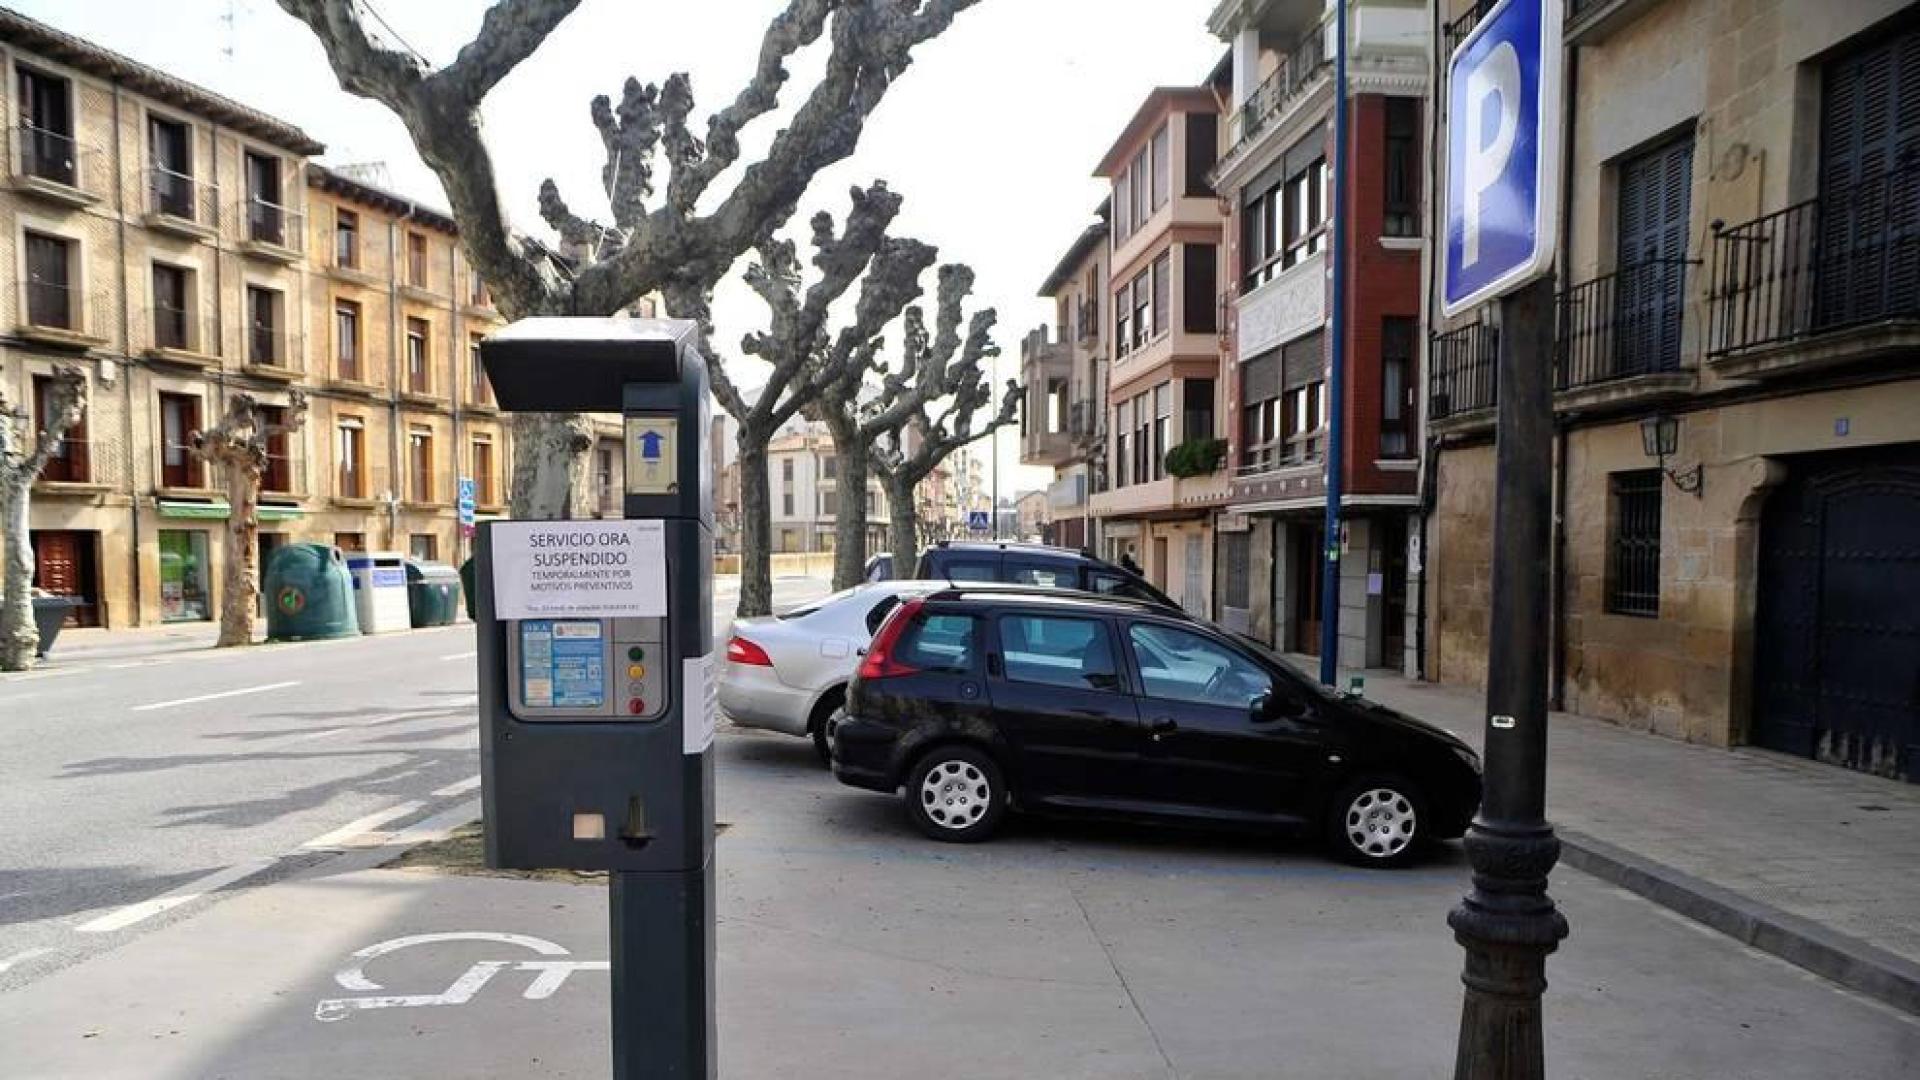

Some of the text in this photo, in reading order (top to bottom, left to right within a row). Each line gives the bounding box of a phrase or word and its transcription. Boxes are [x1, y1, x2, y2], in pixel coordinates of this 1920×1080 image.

[1462, 40, 1522, 270] P
[529, 533, 631, 547] SERVICIO ORA
[533, 552, 628, 567] SUSPENDIDO
[532, 570, 631, 579] TEMPORALMENTE POR
[530, 581, 633, 591] MOTIVOS PREVENTIVOS
